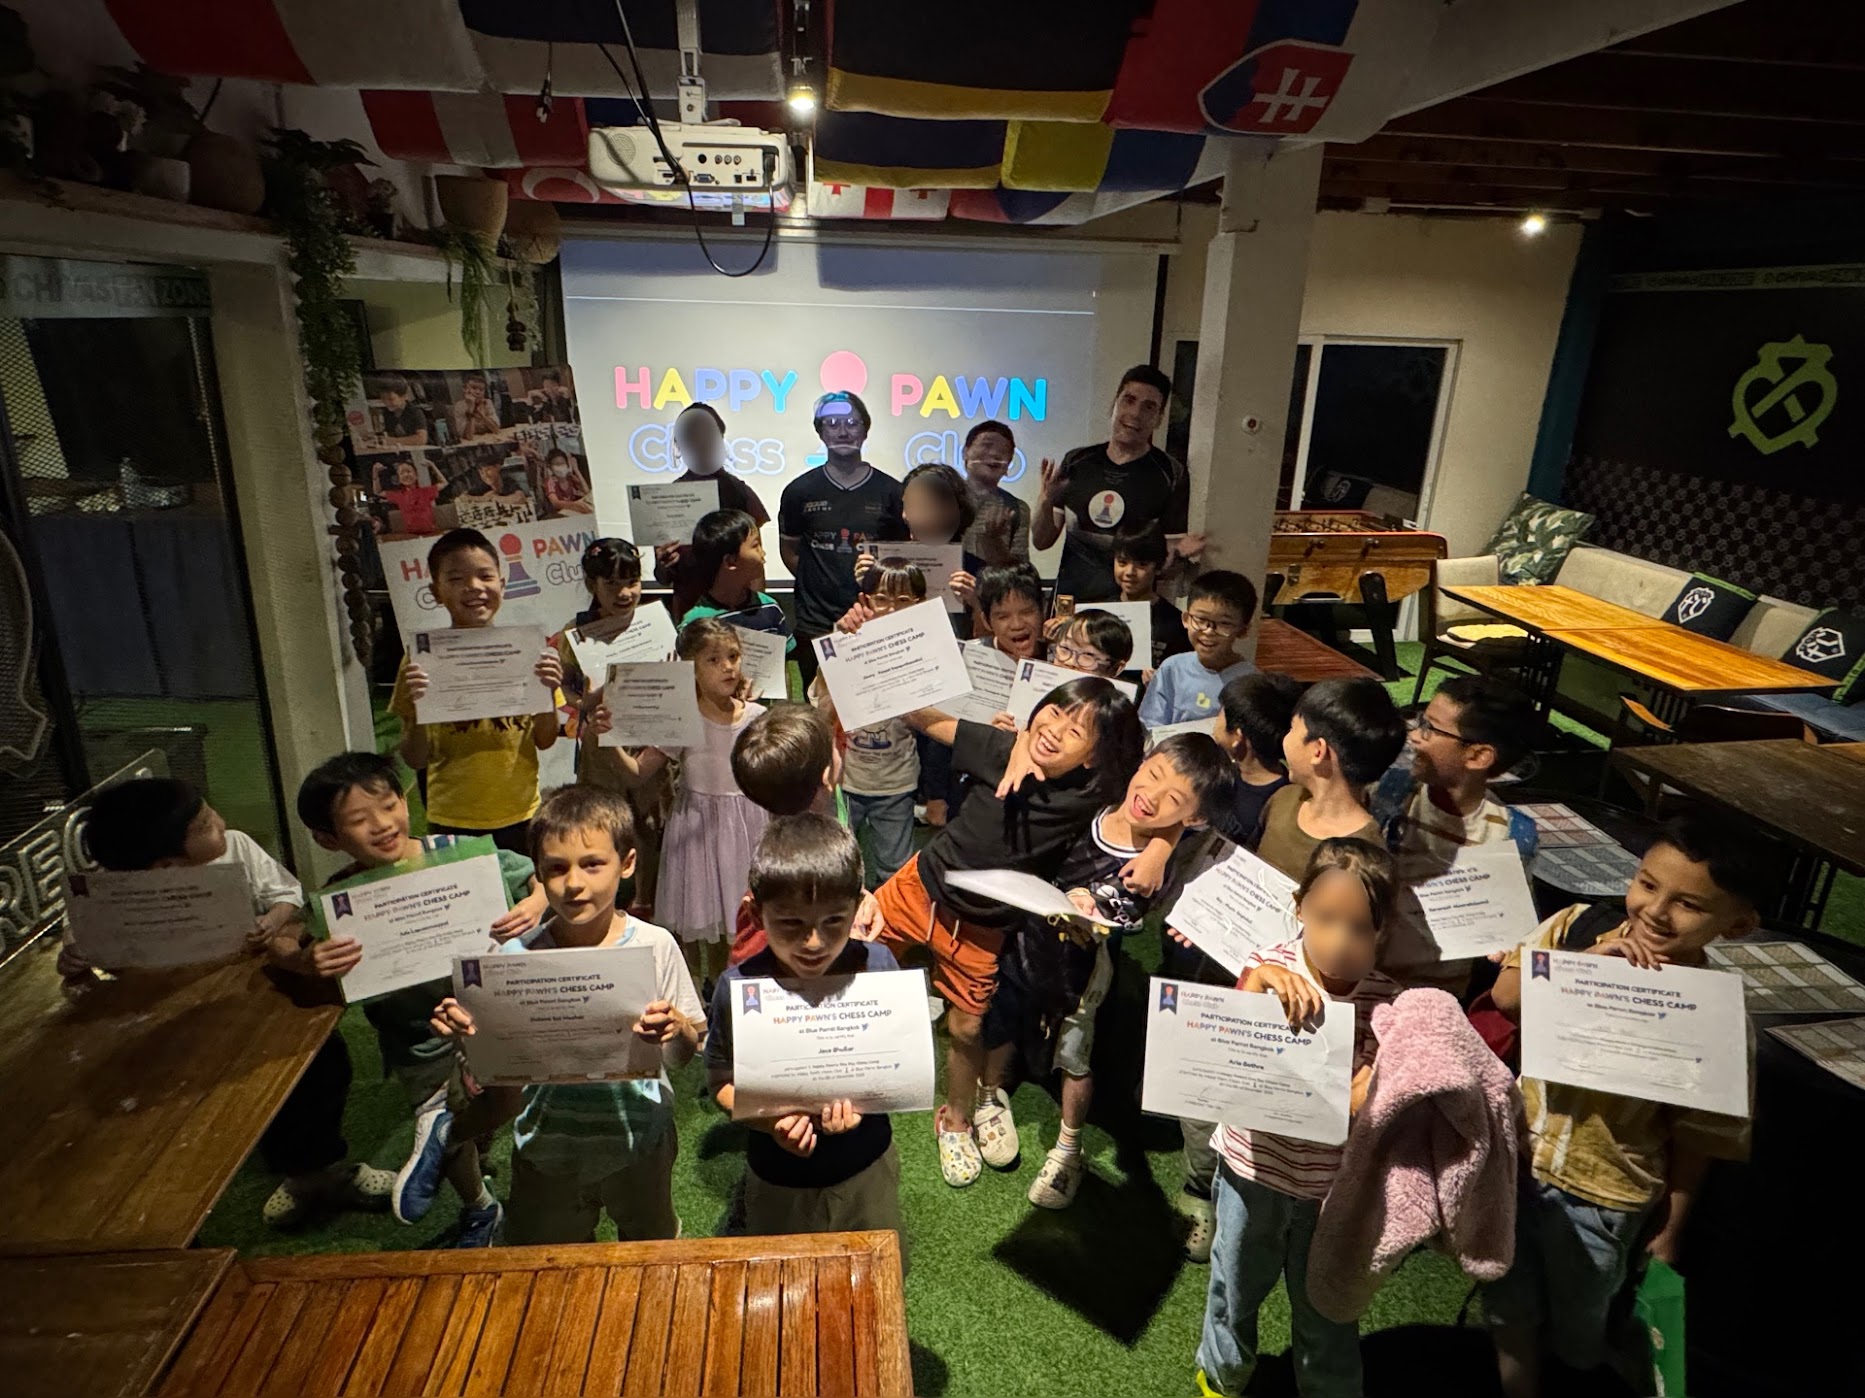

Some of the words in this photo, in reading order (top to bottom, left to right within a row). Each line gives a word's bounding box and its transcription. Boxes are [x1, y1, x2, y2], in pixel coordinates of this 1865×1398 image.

[614, 366, 798, 413] HAPPY
[892, 374, 1047, 421] PAWN
[629, 424, 785, 475] Css
[546, 560, 586, 586] Clu
[888, 638, 907, 649] CHESS
[908, 631, 925, 642] CAMP
[423, 895, 447, 906] CHESS
[449, 889, 470, 900] CAMP
[506, 978, 557, 986] PARTICIPATION
[558, 974, 601, 983] CERTIFICATE
[560, 985, 588, 993] CHESS
[590, 982, 615, 992] CAMP
[1575, 979, 1630, 991] PARTICIPATION
[1631, 986, 1681, 998] CERTIFICATE
[837, 1000, 878, 1008] CERTIFICATE
[1632, 996, 1664, 1008] CHESS
[1667, 1001, 1697, 1011] CAMP
[773, 1015, 802, 1024] HAPPY
[805, 1013, 837, 1022] PAWN'S
[839, 1011, 866, 1020] CHESS
[868, 1010, 892, 1018] CAMP
[1201, 1013, 1252, 1026] PARTICIPATION
[1253, 1021, 1291, 1031] CERTIFICA
[1187, 1021, 1216, 1032] HAPPY
[1219, 1026, 1252, 1037] PAWN'S
[1254, 1032, 1283, 1042] CHESS
[1285, 1036, 1312, 1046] CAMP
